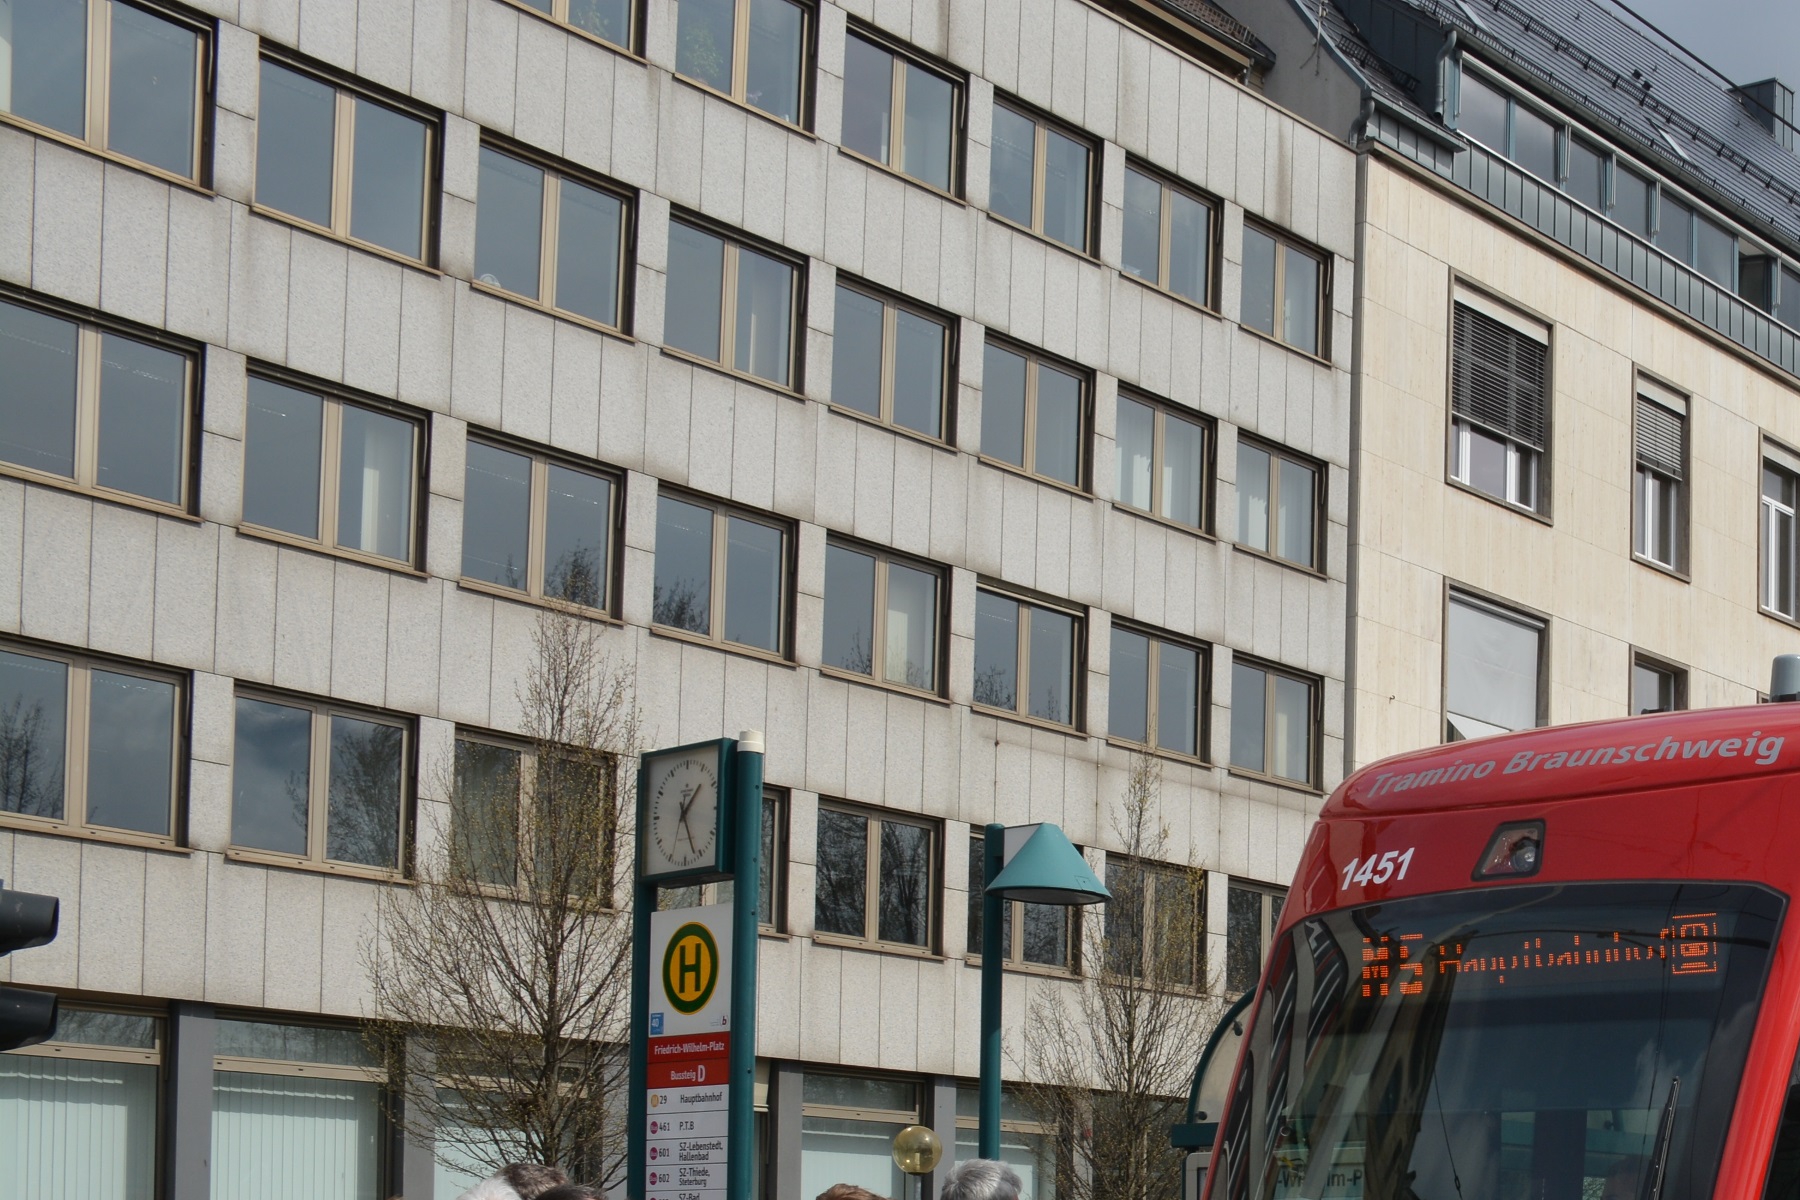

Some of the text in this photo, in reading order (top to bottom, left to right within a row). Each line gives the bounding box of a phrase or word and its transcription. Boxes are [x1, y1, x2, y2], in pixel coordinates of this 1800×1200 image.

[1367, 730, 1785, 799] Tramino Braunschweig
[1341, 847, 1416, 891] 1451
[678, 942, 702, 994] H
[654, 1041, 725, 1055] Friedrich-Wilhelm-Platz
[670, 1064, 706, 1082] Bussteig D
[659, 1095, 668, 1104] 29
[680, 1091, 723, 1105] Hauptbahnhof
[659, 1122, 670, 1131] 461
[679, 1121, 694, 1131] P.T.B
[658, 1148, 670, 1157] 601
[679, 1141, 723, 1151] SZ-Lebenstedt,
[678, 1152, 709, 1161] Hallenbad
[658, 1174, 670, 1183] 602
